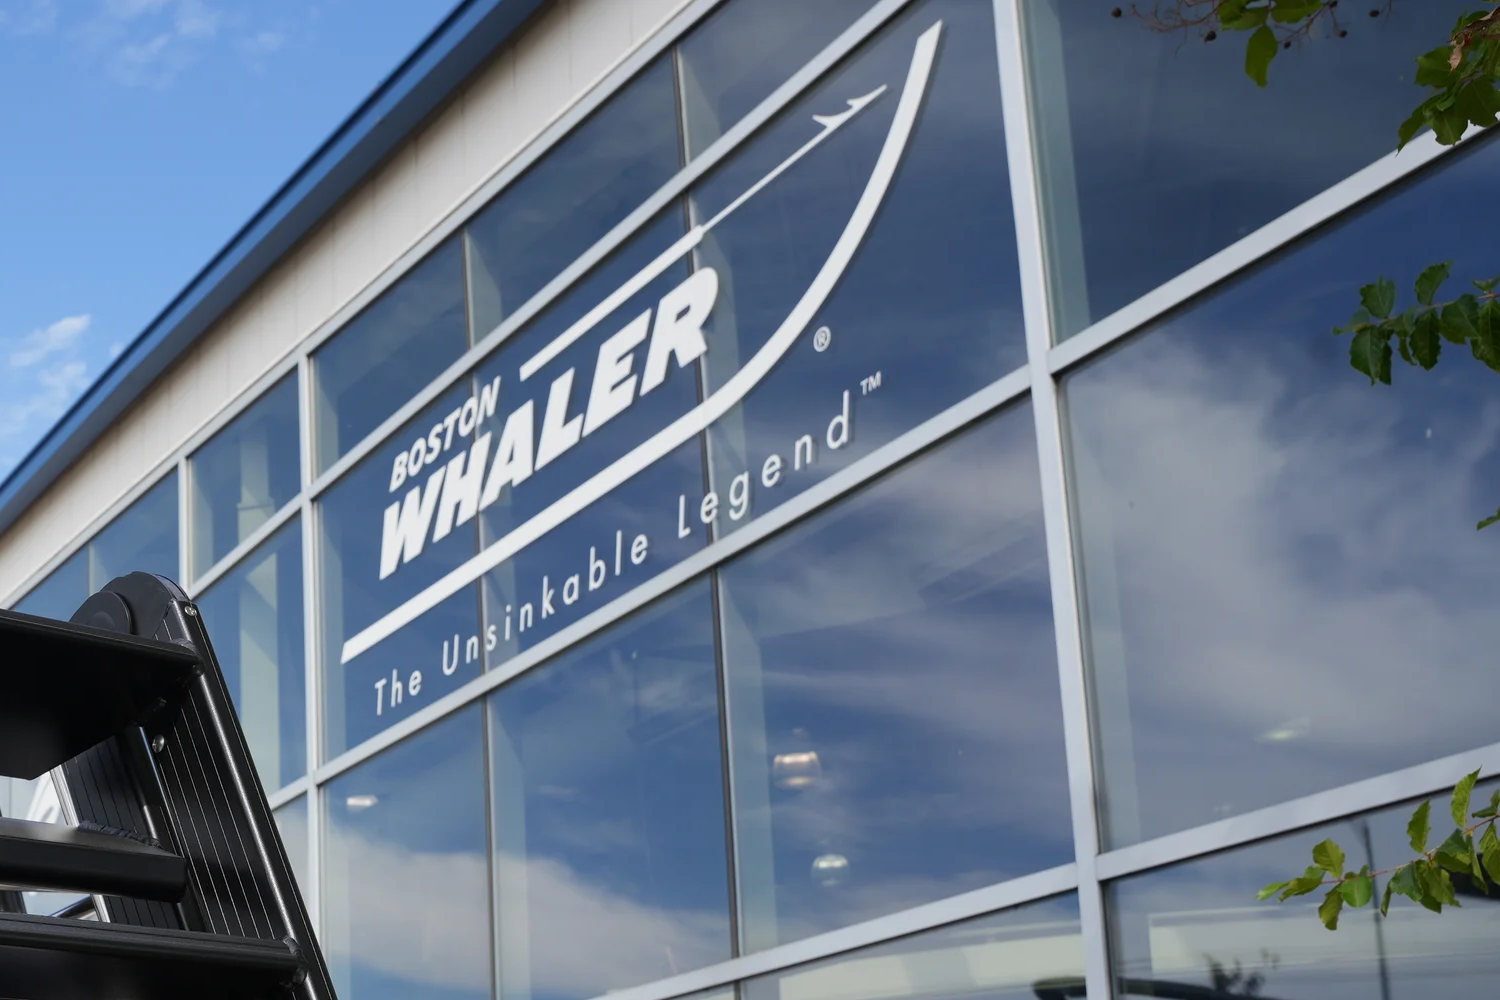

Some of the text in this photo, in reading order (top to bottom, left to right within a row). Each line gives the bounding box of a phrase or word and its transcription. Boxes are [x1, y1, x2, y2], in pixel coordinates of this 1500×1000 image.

[379, 266, 719, 580] WHALER
[389, 376, 501, 492] BOSTON
[374, 669, 423, 717] The
[442, 530, 648, 676] Unsinkable
